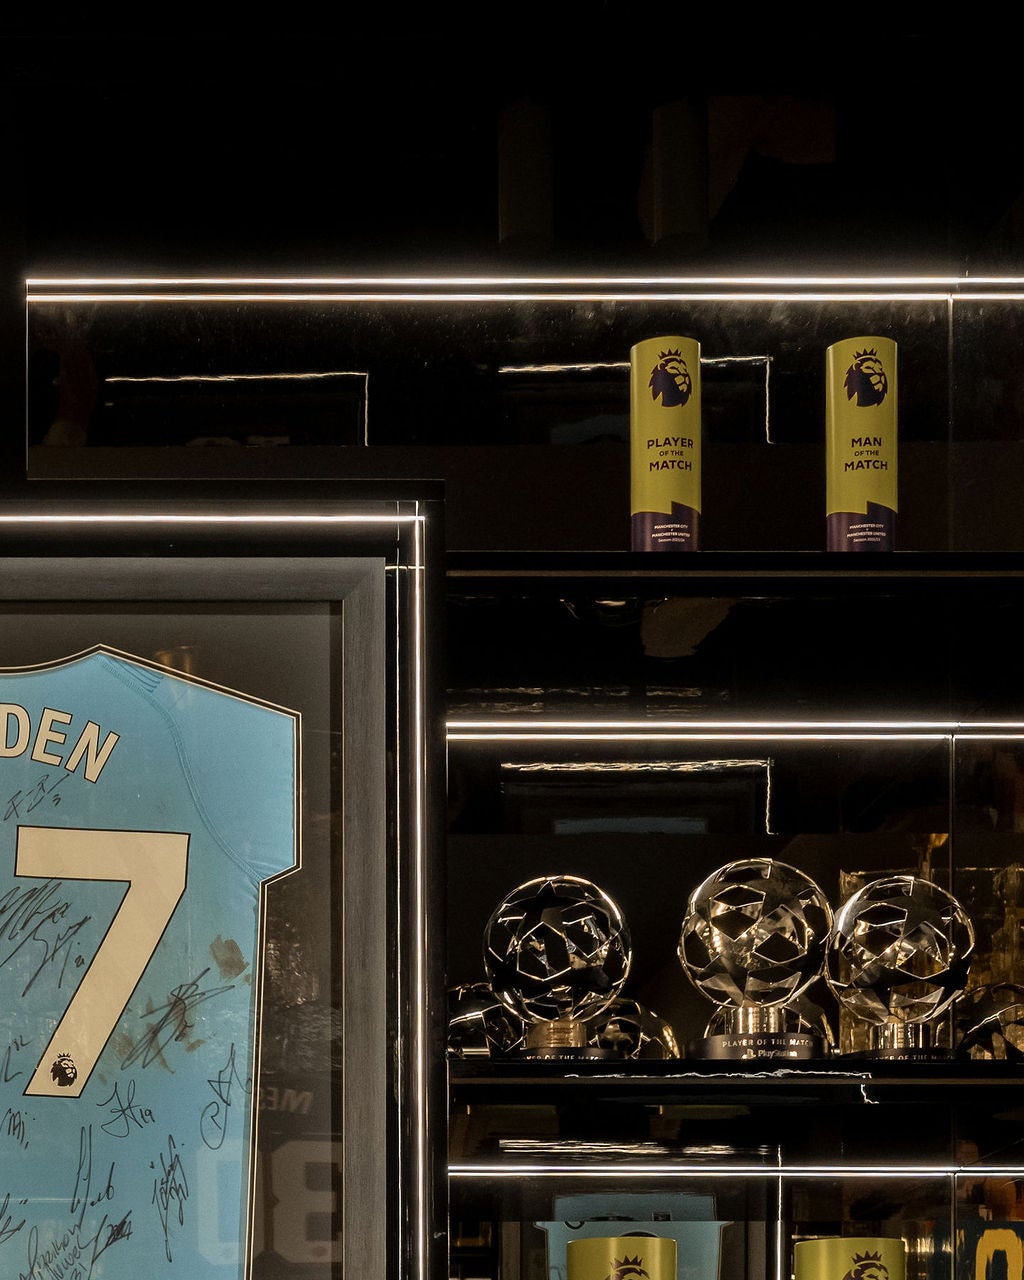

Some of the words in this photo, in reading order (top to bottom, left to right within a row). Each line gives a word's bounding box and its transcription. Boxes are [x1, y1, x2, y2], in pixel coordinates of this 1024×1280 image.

[647, 437, 693, 449] PLAYER
[851, 437, 882, 448] MAN
[649, 460, 692, 472] MATCH
[844, 460, 888, 472] MATCH
[722, 1039, 754, 1048] PLAYER
